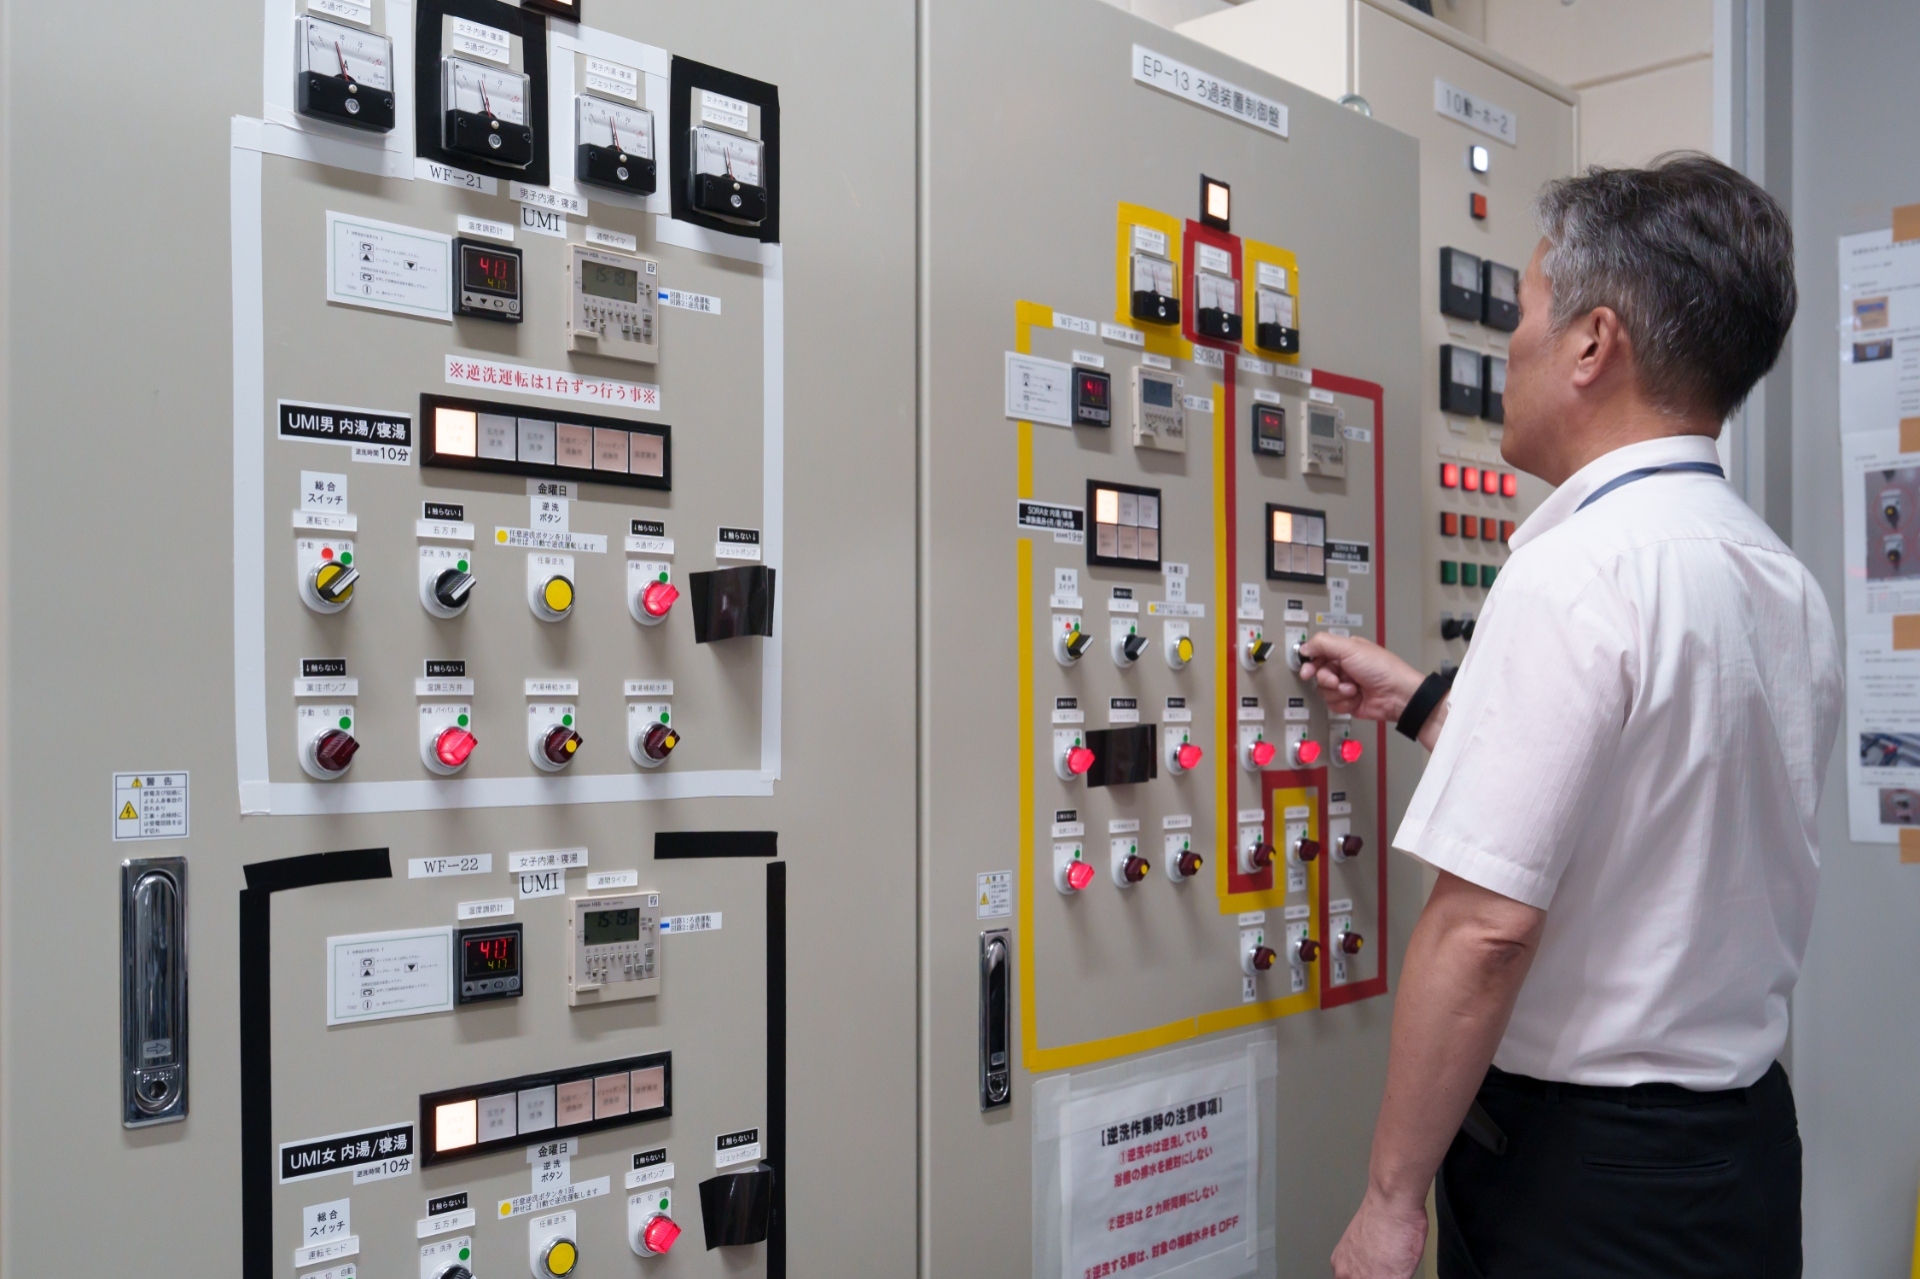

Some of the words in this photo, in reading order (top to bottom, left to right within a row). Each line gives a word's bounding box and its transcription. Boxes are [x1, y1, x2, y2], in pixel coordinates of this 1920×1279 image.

[321, 1, 359, 16] ろ過ポンプ
[464, 41, 499, 57] ろ過ポンプ
[1142, 56, 1190, 91] EP-13
[590, 76, 633, 95] ジェットポンプ
[429, 164, 484, 190] WF-21
[520, 187, 579, 211] 男子内湯・寝湯
[522, 207, 562, 232] UMI
[468, 221, 503, 235] 温度調節計
[1060, 316, 1090, 332] WF-13
[1195, 349, 1223, 366] SORA
[287, 411, 335, 433] UMI男
[338, 417, 407, 440] 内湯/寝湯
[537, 483, 567, 497] 金曜日
[308, 493, 343, 505] スイッチ
[542, 502, 560, 512] 逆洗
[306, 515, 344, 526] 運転モード
[539, 512, 561, 523] ボタン
[433, 526, 458, 535] 五方弁
[635, 541, 665, 550] ろ過ポンプ
[719, 547, 757, 557] ジェットポンプ
[306, 683, 346, 692] 薬注ポンプ
[423, 858, 479, 874] WF-22
[519, 853, 579, 868] 女子内湯・寝湯
[520, 872, 560, 895] UMI
[597, 875, 628, 885] 週間タイマ
[468, 904, 504, 915] 温度調節計
[290, 1145, 335, 1170] UMI女
[341, 1133, 408, 1159] 内湯/寝湯
[537, 1142, 568, 1158] 金曜日
[719, 1147, 757, 1164] ジェットポンプ
[543, 1159, 562, 1171] 逆洗
[540, 1170, 563, 1182] ボタン
[635, 1169, 665, 1183] ろ過ポンプ
[316, 1209, 339, 1223] 総合
[310, 1221, 346, 1238] スイッチ
[434, 1218, 458, 1230] 五方弁
[308, 1243, 347, 1260] 運転モード
